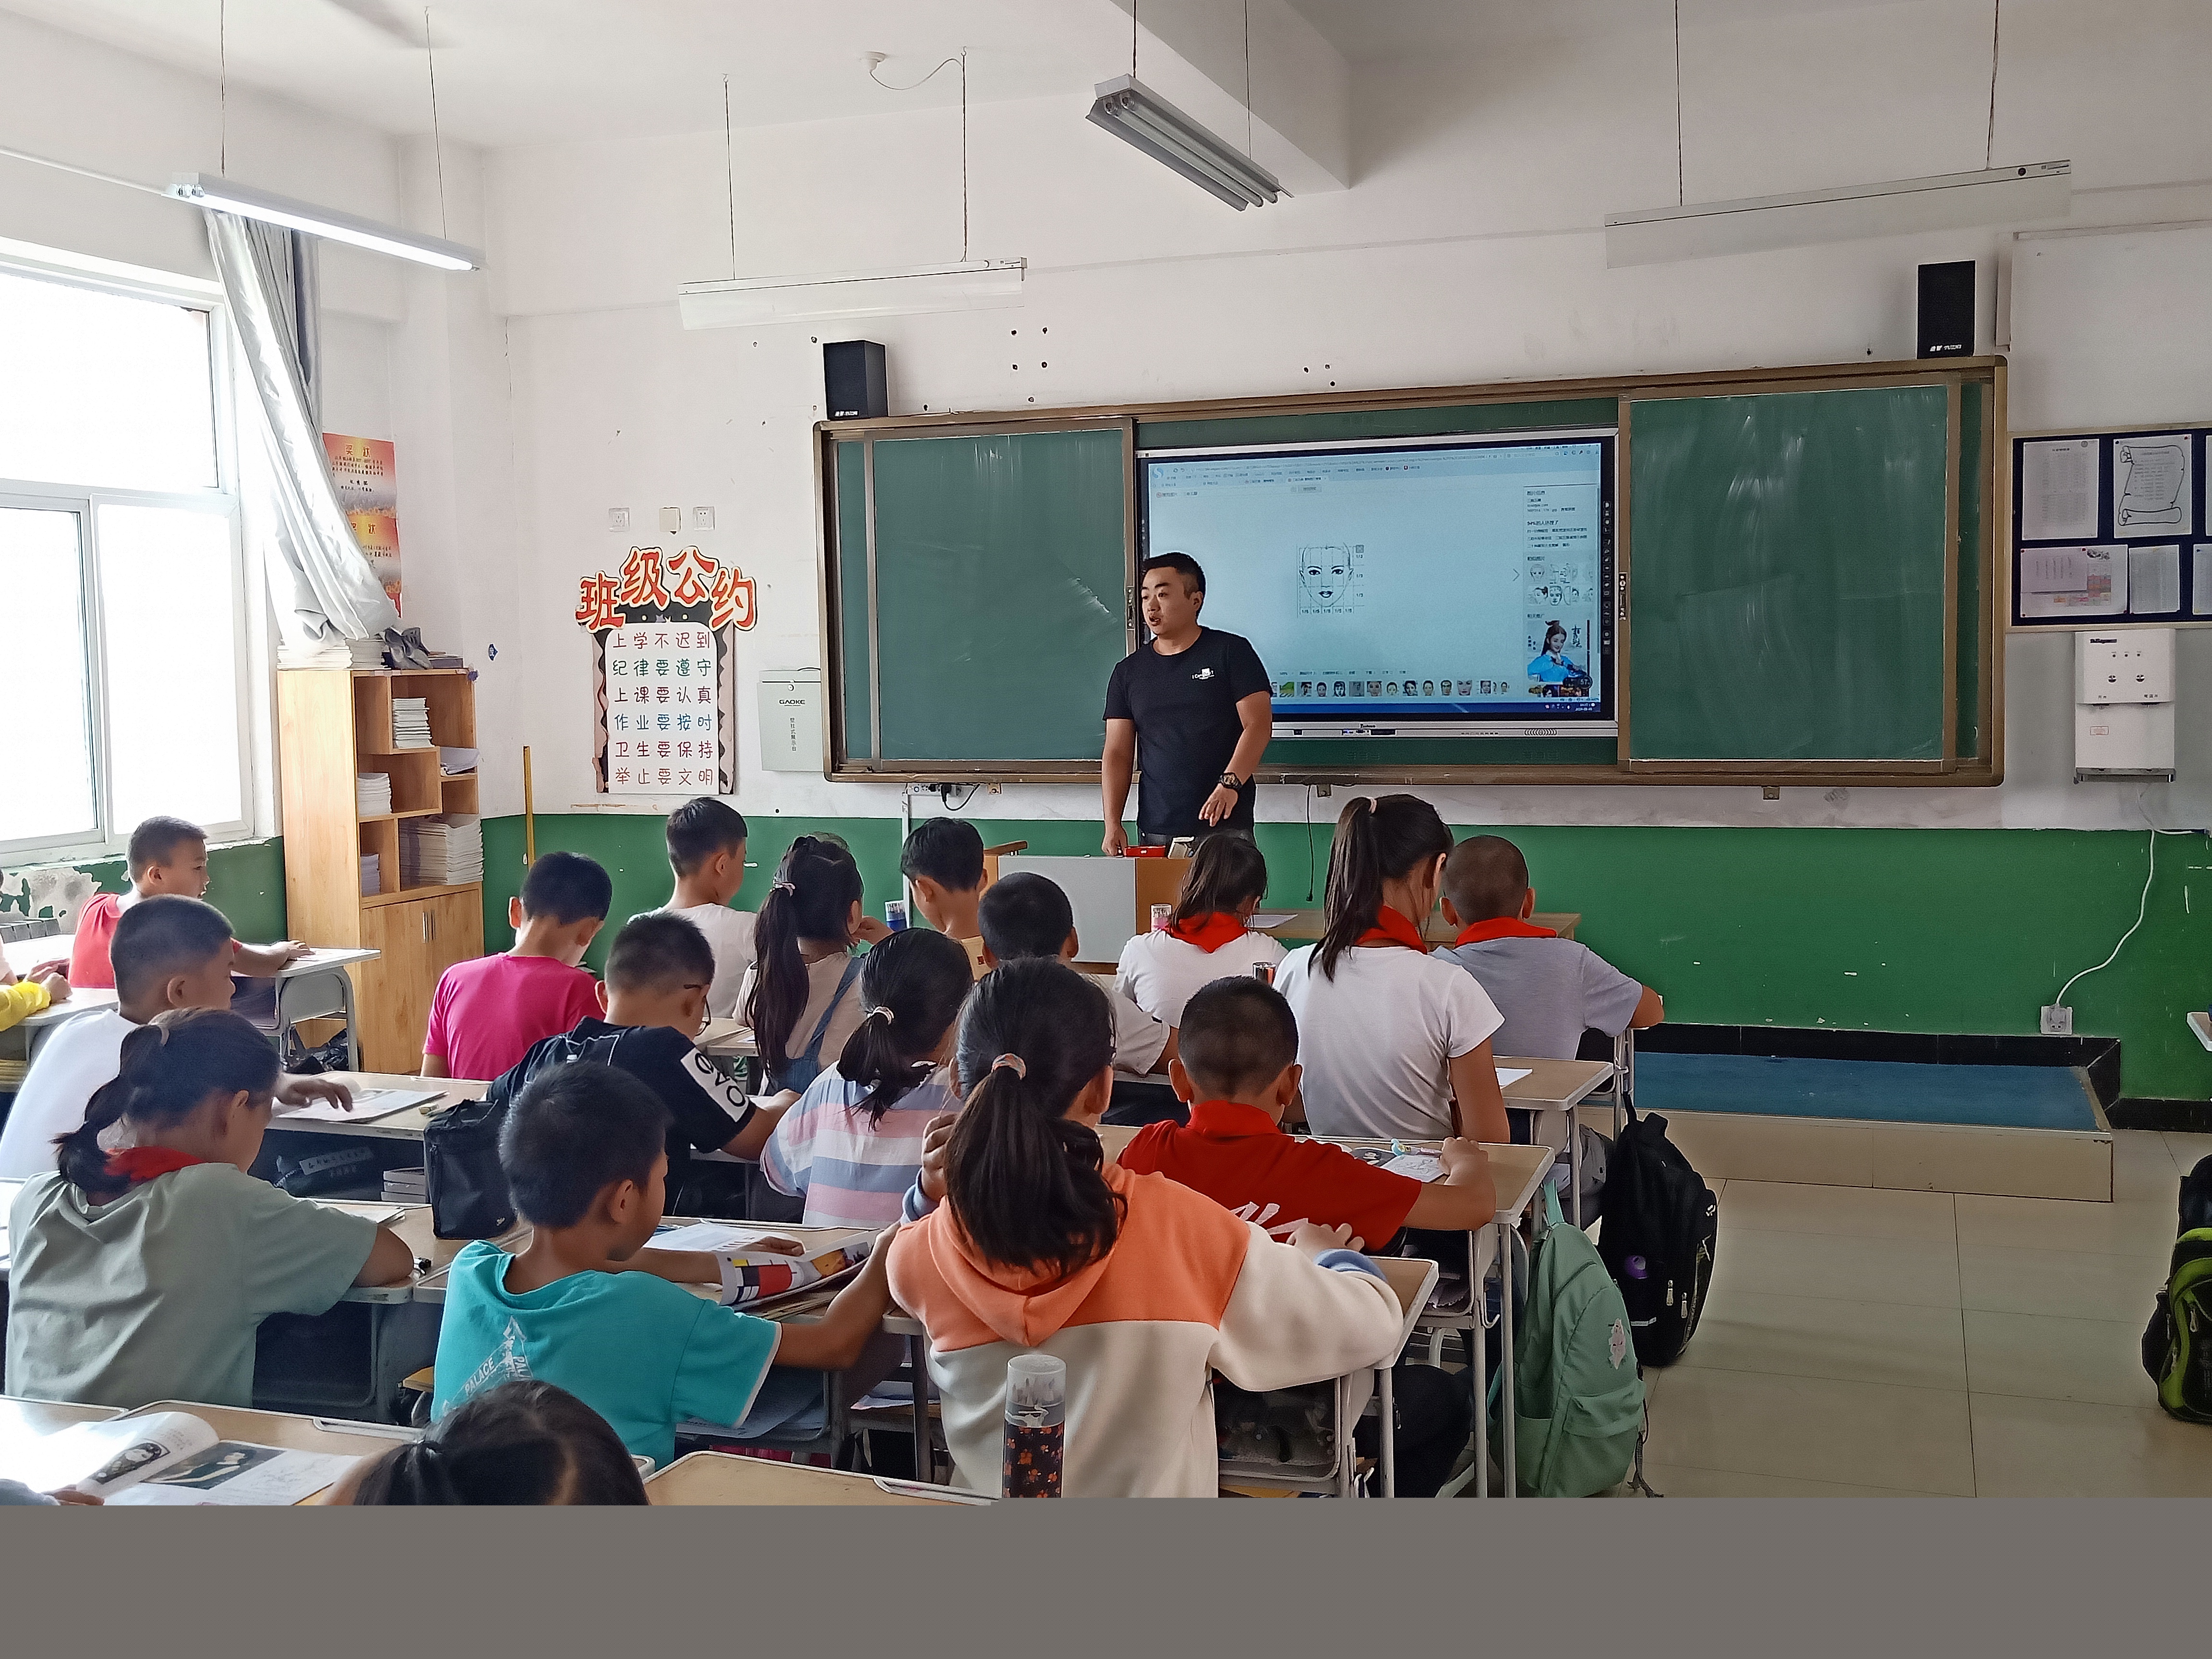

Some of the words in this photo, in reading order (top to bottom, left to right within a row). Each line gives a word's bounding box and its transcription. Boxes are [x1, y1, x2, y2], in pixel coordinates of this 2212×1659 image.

[576, 547, 756, 631] 班级公约
[613, 632, 710, 649] 上学不迟到
[613, 658, 712, 677] 纪律要遵守
[614, 686, 712, 704] 上课要认真
[614, 713, 712, 731] 作业要按时
[615, 741, 713, 758] 卫生要保持
[615, 767, 713, 786] 举止要文明
[464, 1357, 494, 1396] PALACE
